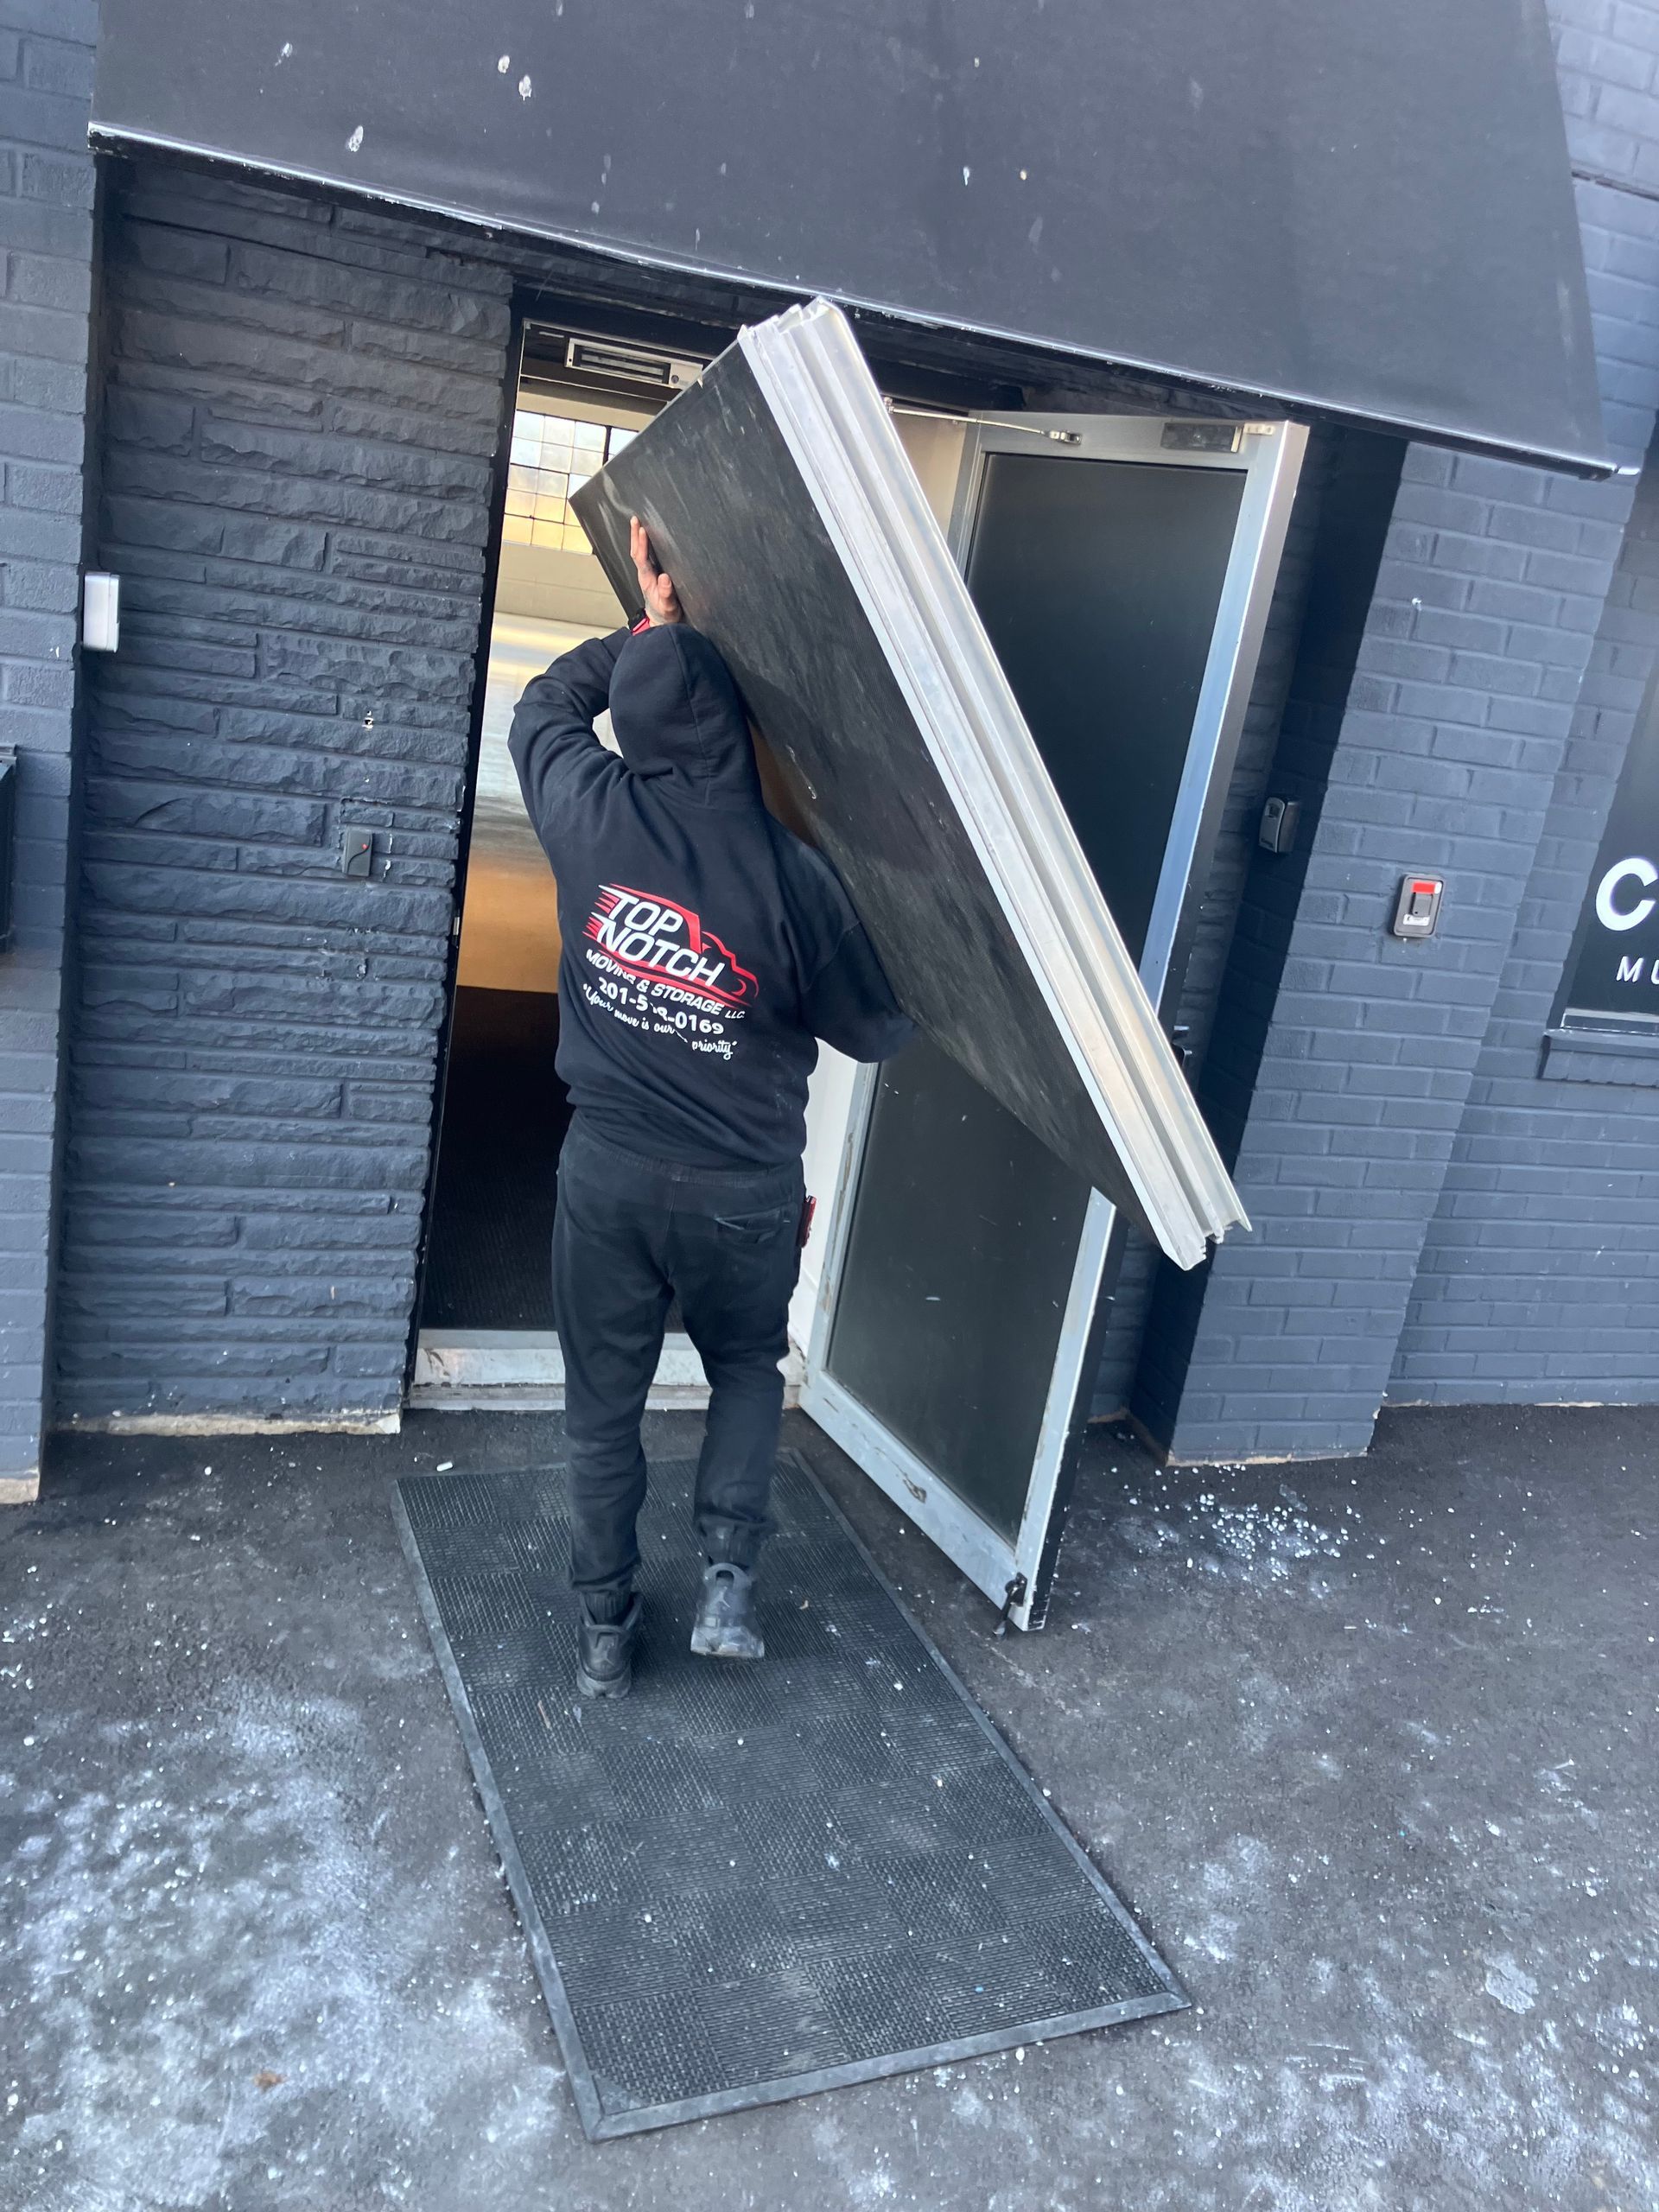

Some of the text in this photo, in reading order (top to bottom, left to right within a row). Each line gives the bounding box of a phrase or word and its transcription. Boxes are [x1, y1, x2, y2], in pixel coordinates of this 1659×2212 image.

[598, 884, 683, 936] TOP
[591, 912, 725, 986] NOTCH
[586, 949, 637, 985] MOVING
[636, 979, 651, 993] &
[651, 983, 725, 1015] STORAGE
[613, 1008, 639, 1027] move
[641, 1016, 650, 1031] is
[653, 1022, 676, 1034] our
